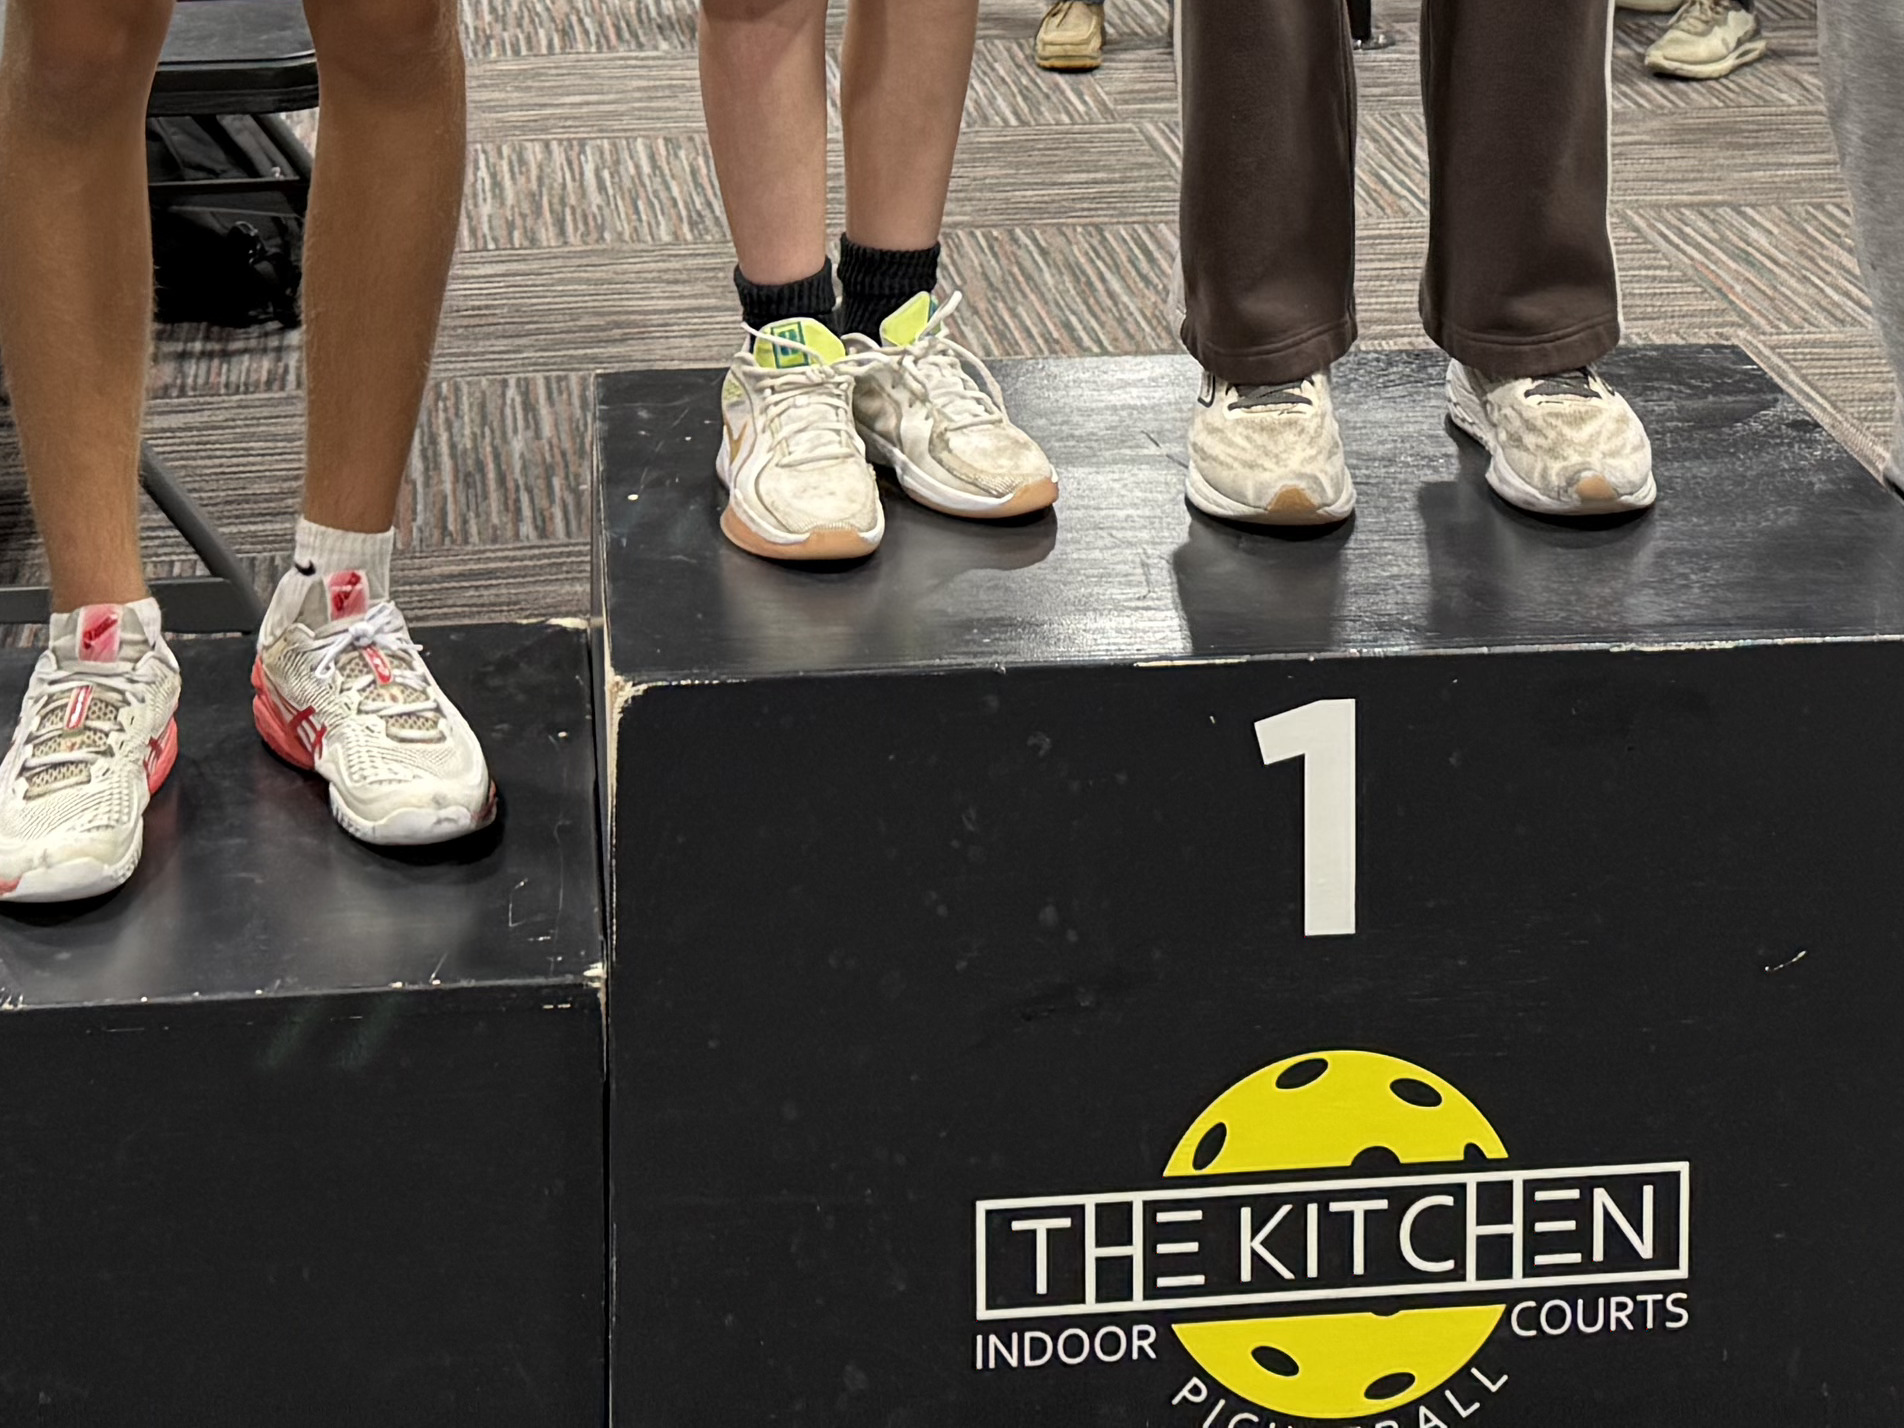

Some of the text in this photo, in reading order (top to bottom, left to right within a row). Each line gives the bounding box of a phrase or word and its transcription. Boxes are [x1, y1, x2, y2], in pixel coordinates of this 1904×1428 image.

[1253, 697, 1356, 936] 1
[1010, 1180, 1655, 1302] THE KITCHEN
[975, 1323, 1158, 1372] INDOOR
[1510, 1292, 1690, 1339] COURTS
